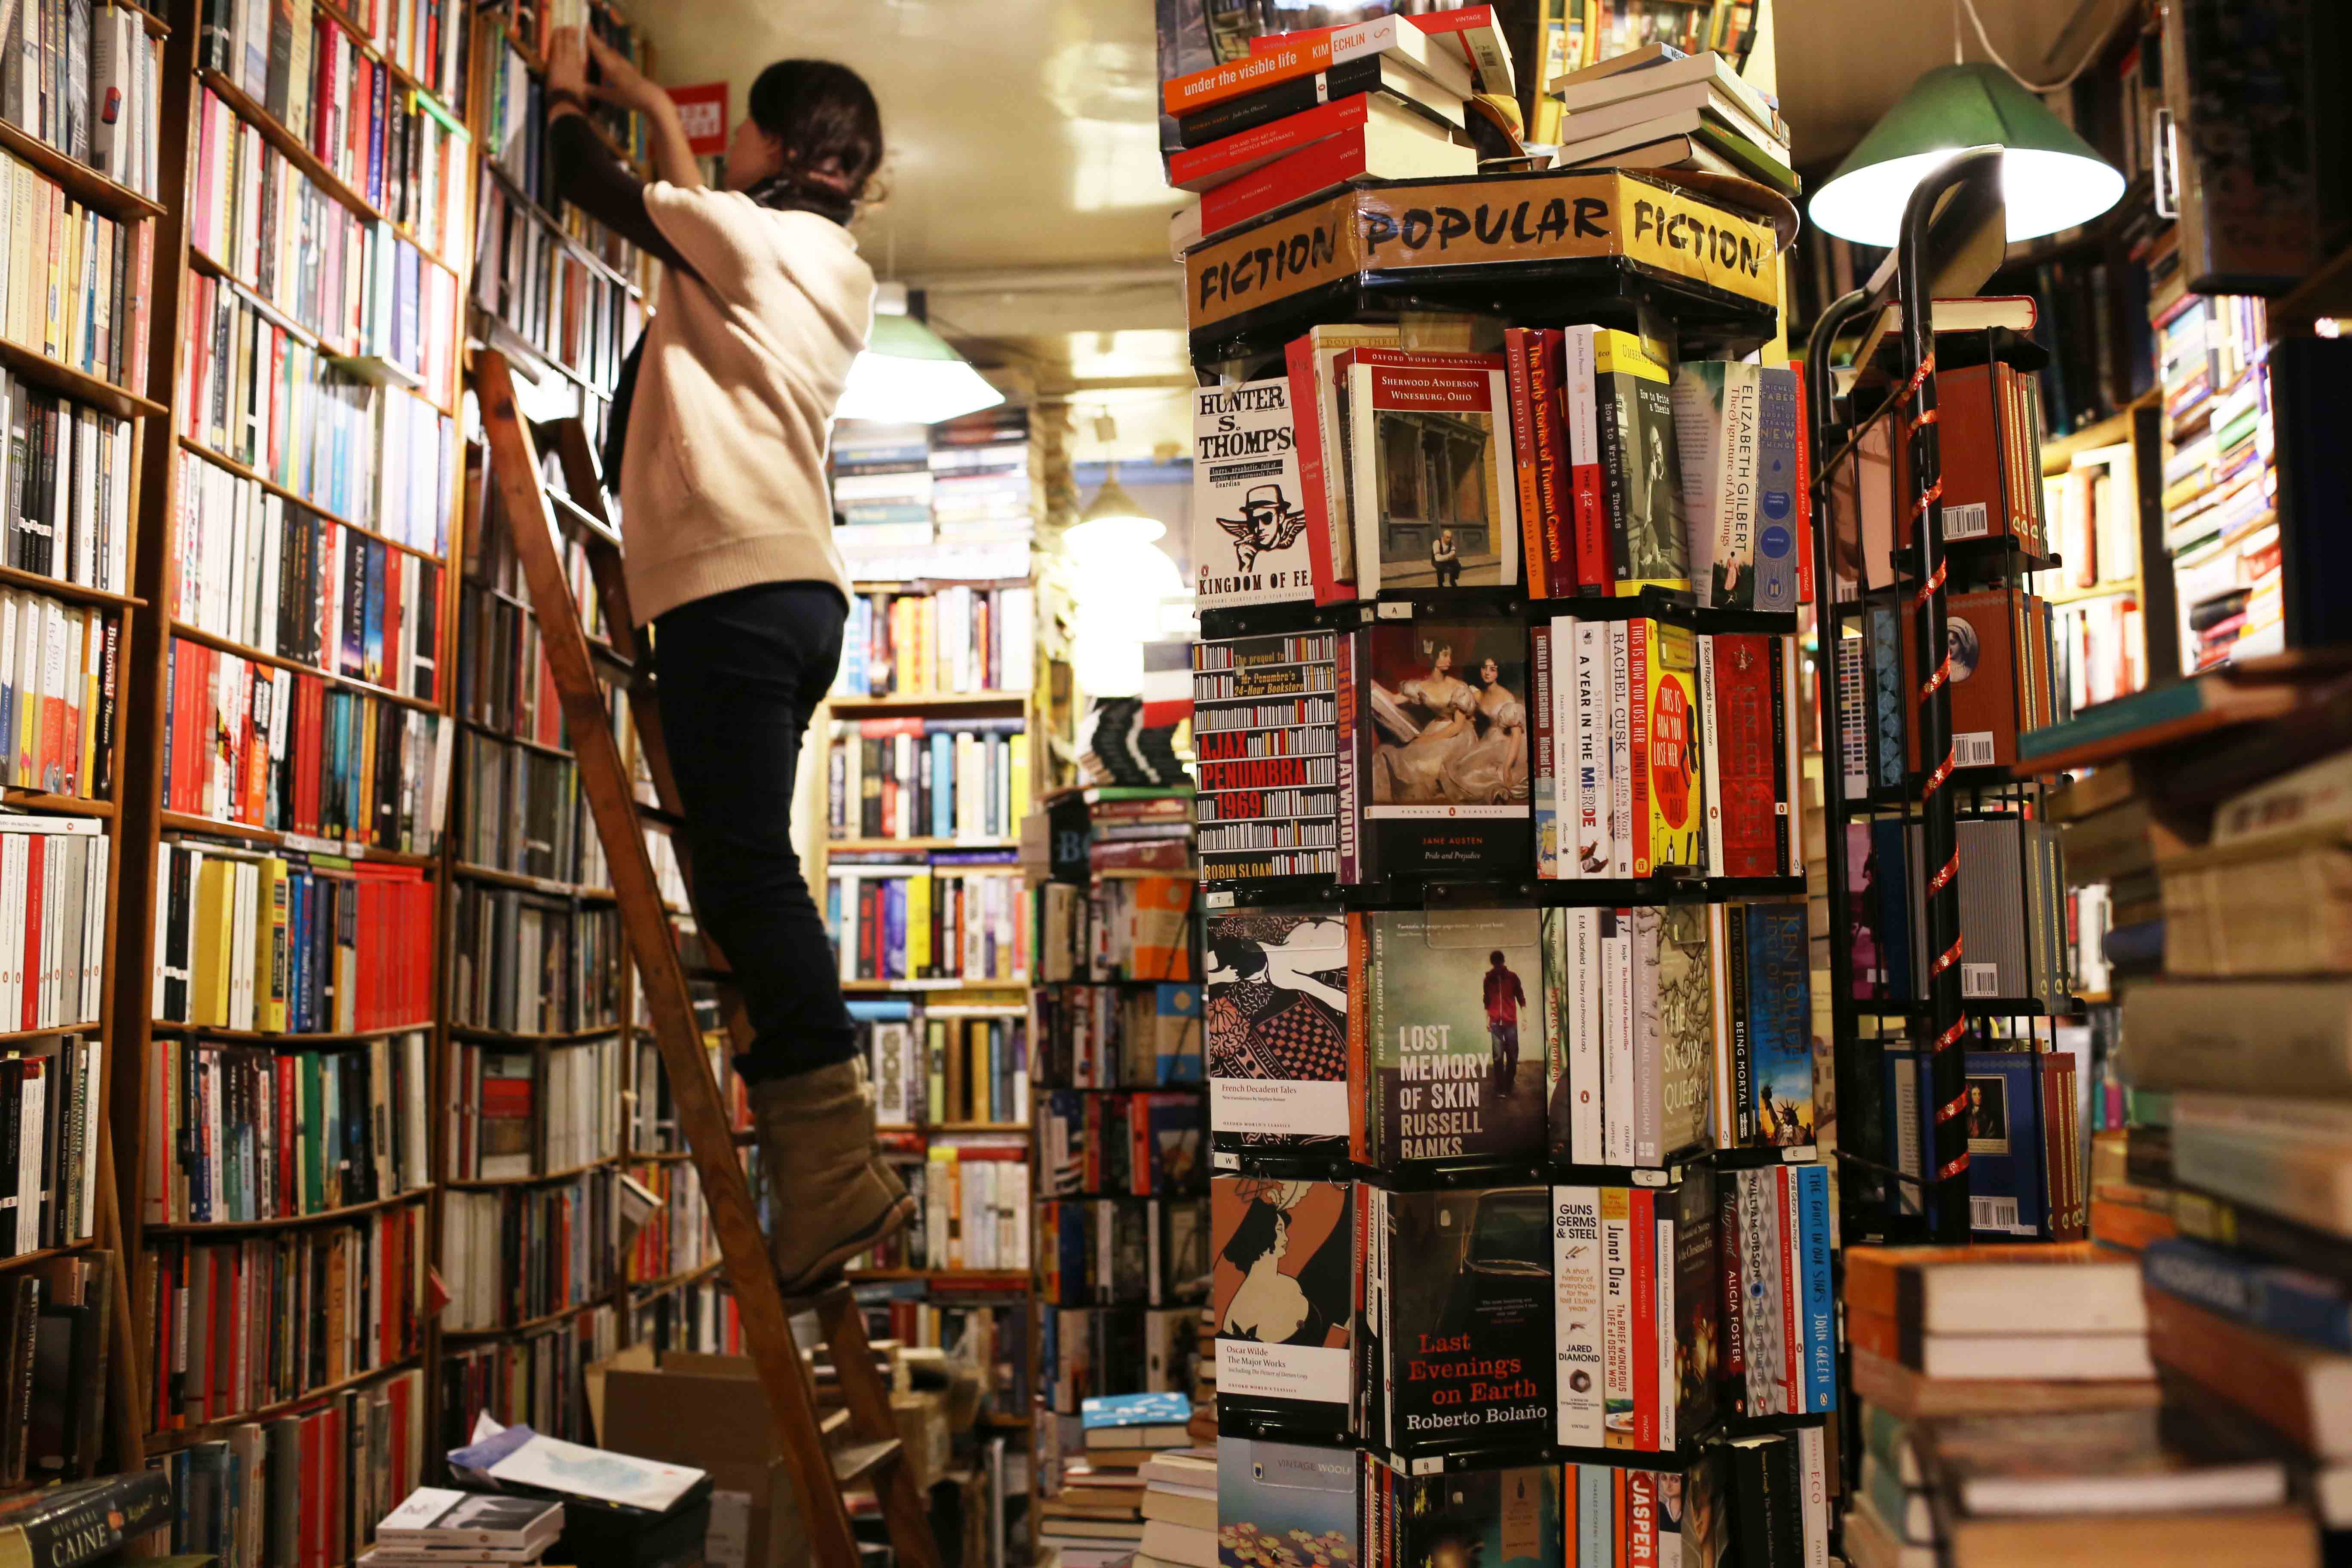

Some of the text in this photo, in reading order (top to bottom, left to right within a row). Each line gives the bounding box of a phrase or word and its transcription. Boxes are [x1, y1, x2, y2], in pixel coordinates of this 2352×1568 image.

[1455, 13, 1481, 22] VINTAGE
[1312, 43, 1329, 59] KIM
[1333, 34, 1365, 52] ECHLIN
[1184, 52, 1297, 96] under the visible life
[1338, 106, 1361, 117] VINTAGE
[1229, 142, 1239, 150] ZEN
[1261, 133, 1270, 141] ART
[1230, 131, 1295, 156] MOTORCYCLE MAINTENANCE
[1340, 148, 1359, 160] VINTAGE
[1200, 197, 1761, 312] FICTION POPULAR FICTION
[1200, 386, 1285, 415] HUNTER
[1510, 348, 1526, 450] JOSEPH BOYDEN
[1639, 389, 1669, 404] How to Write
[1654, 404, 1669, 415] Thesis
[1761, 392, 1795, 402] FABER
[1218, 415, 1241, 432] S.
[1605, 403, 1613, 422] How
[1199, 426, 1296, 459] THOMPS
[1607, 428, 1614, 440] to
[1761, 429, 1795, 440] NEW
[1609, 444, 1617, 475] Write
[1721, 386, 1740, 547] The Signature of All Things
[1735, 386, 1753, 553] ELIZABETH GILBERT
[1799, 482, 1804, 491] OF
[1612, 492, 1621, 529] Thesis
[1199, 574, 1262, 595] KINGDOM
[1270, 572, 1286, 588] OF
[1392, 606, 1397, 615] A
[1632, 625, 1644, 644] THIS
[105, 626, 117, 701] Bukowski
[1234, 651, 1285, 665] The prequel to
[1614, 633, 1626, 702] RACHEL
[1632, 661, 1644, 680] HOW
[1234, 683, 1304, 696] 24-Hour Bookstore
[1254, 671, 1295, 683] Penumbra's
[1537, 635, 1549, 728] EMERALD UNDERGROUND
[1633, 684, 1645, 700] YOU
[1661, 686, 1681, 714] THIS IS
[1633, 704, 1645, 724] LOSE
[1657, 713, 1681, 740] HOW YOU
[1580, 656, 1596, 827] A YEAR IN THE MERDE
[1594, 690, 1605, 790] STEPHEN CLARKE
[1614, 708, 1626, 753] CUSK
[1633, 728, 1645, 743] HER
[1200, 731, 1246, 760] AJAX
[1540, 737, 1551, 765] Michael
[1654, 741, 1678, 767] LOSE HER
[1203, 758, 1307, 790] PENUMBRA
[1216, 790, 1261, 819] 1969
[1340, 763, 1354, 857] ATWOOD
[1425, 851, 1481, 861] Pride and Prejudice
[1204, 862, 1272, 880] ROBIN SLOAN
[1375, 959, 1384, 1012] MEMORY
[1377, 1012, 1384, 1029] OF
[1399, 1024, 1451, 1052] LOST
[1400, 1052, 1490, 1081] MEMORY
[1664, 1037, 1703, 1073] SNOW
[1735, 1021, 1748, 1107] BEING MORTAL
[1222, 1084, 1245, 1092] French
[1246, 1085, 1278, 1093] Decadent
[1641, 1023, 1651, 1135] MICHAEL CUNNINGHAM
[1400, 1082, 1479, 1110] OF SKIN
[1664, 1081, 1703, 1115] QUEEN
[1401, 1111, 1483, 1136] RUSSELL
[1402, 1137, 1462, 1159] BANKS
[1556, 1216, 1596, 1227] GERMS
[1560, 1204, 1592, 1215] GUNS
[1556, 1228, 1598, 1239] & STEEL
[1608, 1225, 1623, 1262] Junot
[1752, 1232, 1761, 1277] GIBSON
[1728, 1271, 1738, 1312] ALICIA
[1227, 1345, 1268, 1356] Oscar Wilde
[1418, 1333, 1471, 1354] Last
[1566, 1344, 1592, 1353] JARED
[1617, 1304, 1627, 1392] The BRIEF WONDROUS
[1731, 1317, 1740, 1363] FOSTER
[1813, 1313, 1829, 1383] JOHN GREEN
[1242, 1357, 1262, 1367] Major
[1263, 1359, 1286, 1368] Works
[1409, 1356, 1522, 1381] Evenings
[1559, 1353, 1600, 1363] DIAMOND
[1432, 1378, 1537, 1405] on Earth
[1406, 1411, 1480, 1430] Roberto
[1485, 1404, 1547, 1424] Bolaño
[1277, 1460, 1352, 1475] VINTAGE WOOLF
[1811, 1472, 1820, 1504] ECO
[1633, 1480, 1651, 1558] JASPER
[52, 1523, 108, 1568] CAINE
